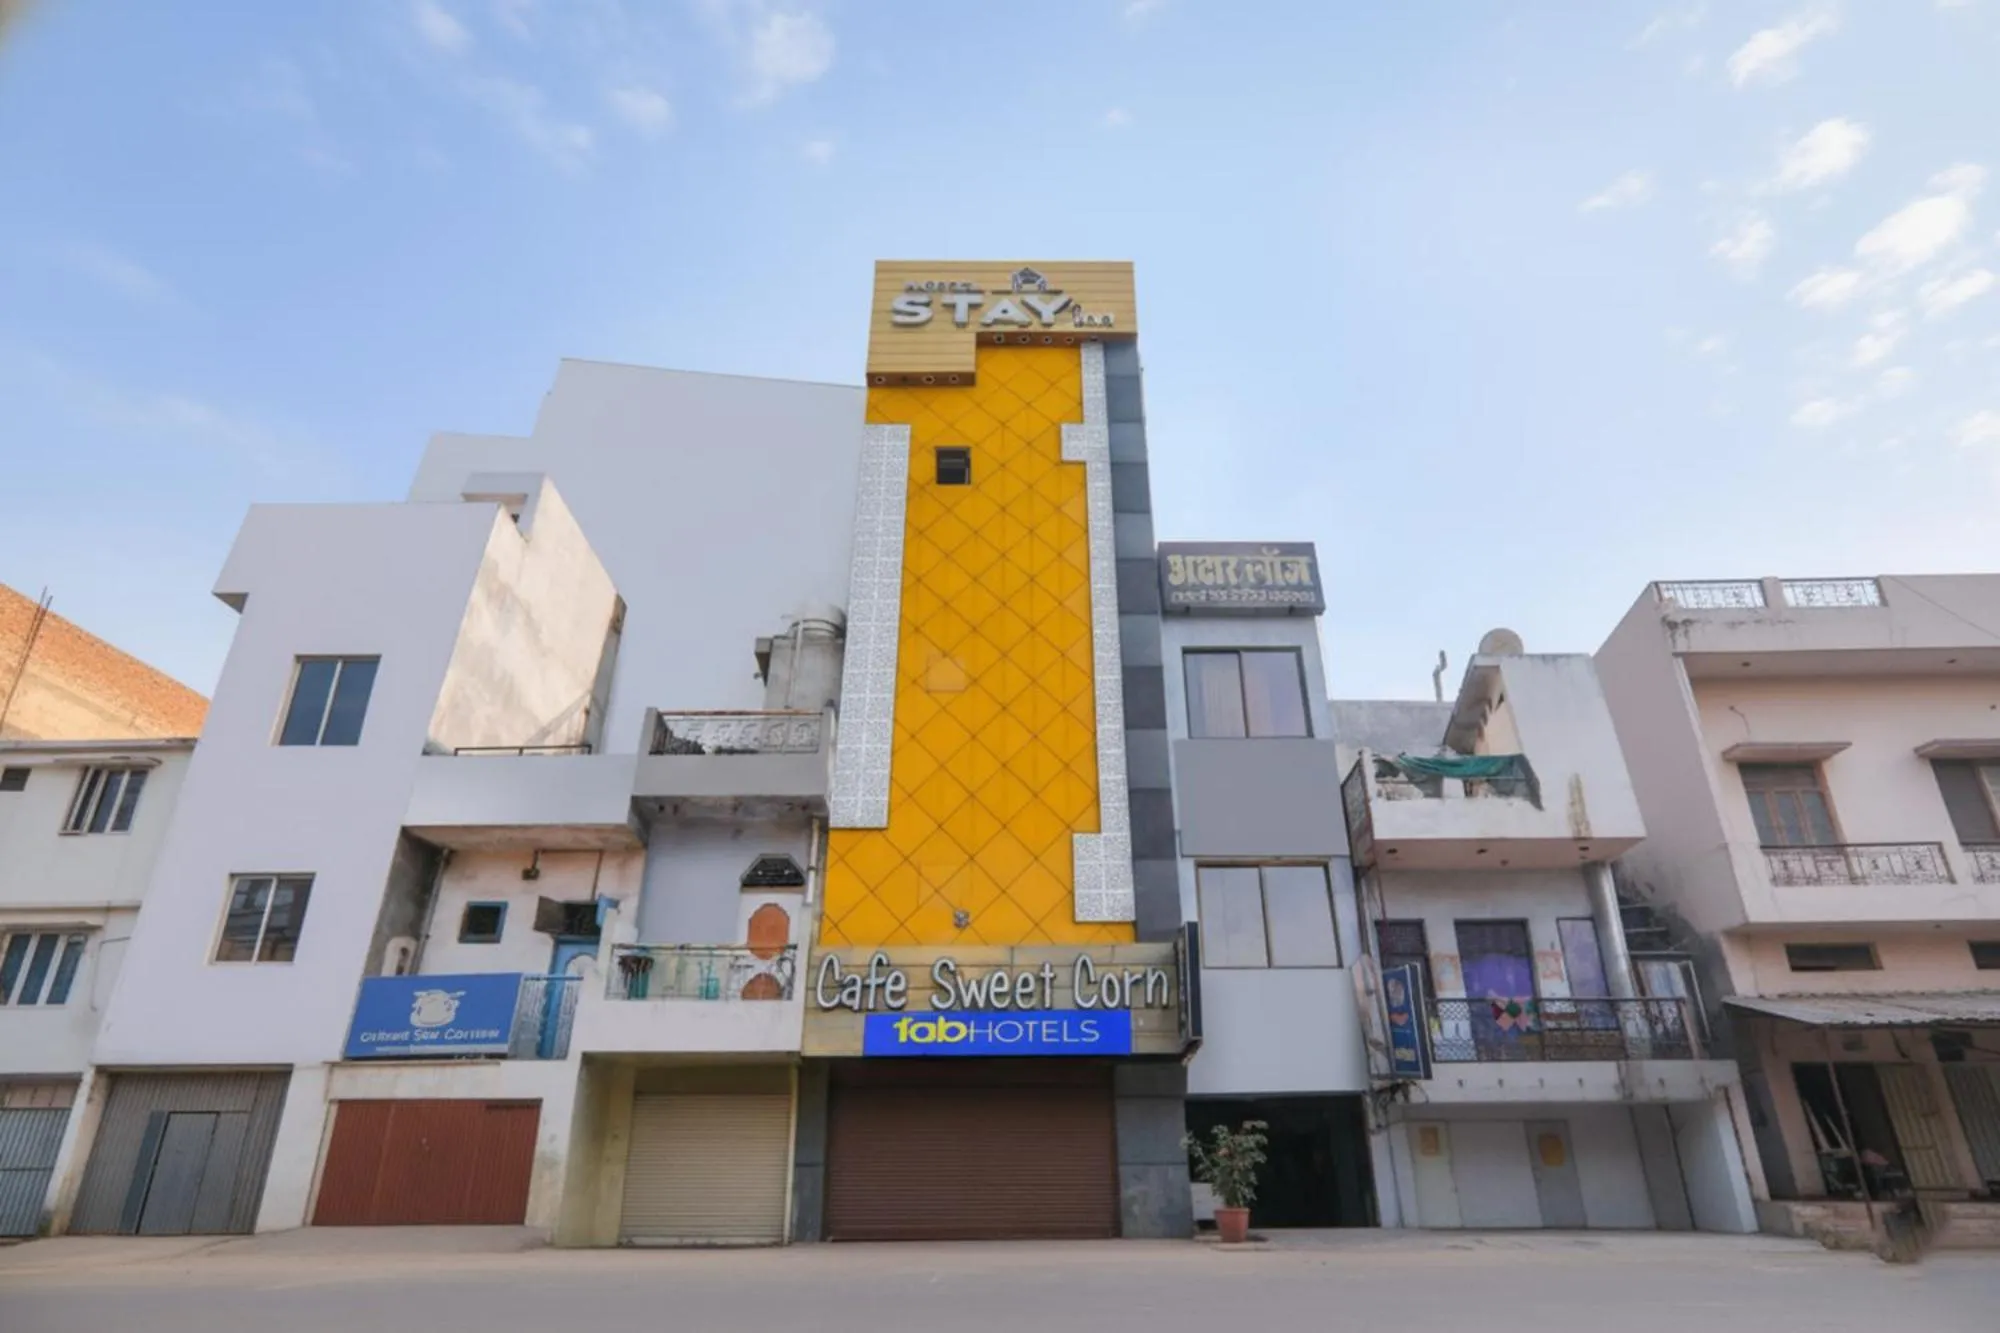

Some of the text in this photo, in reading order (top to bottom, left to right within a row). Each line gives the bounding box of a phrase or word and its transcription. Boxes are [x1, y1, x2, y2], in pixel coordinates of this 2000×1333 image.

[891, 294, 1072, 328] STAY
[816, 952, 1170, 1010] Cafe Sweet Corn
